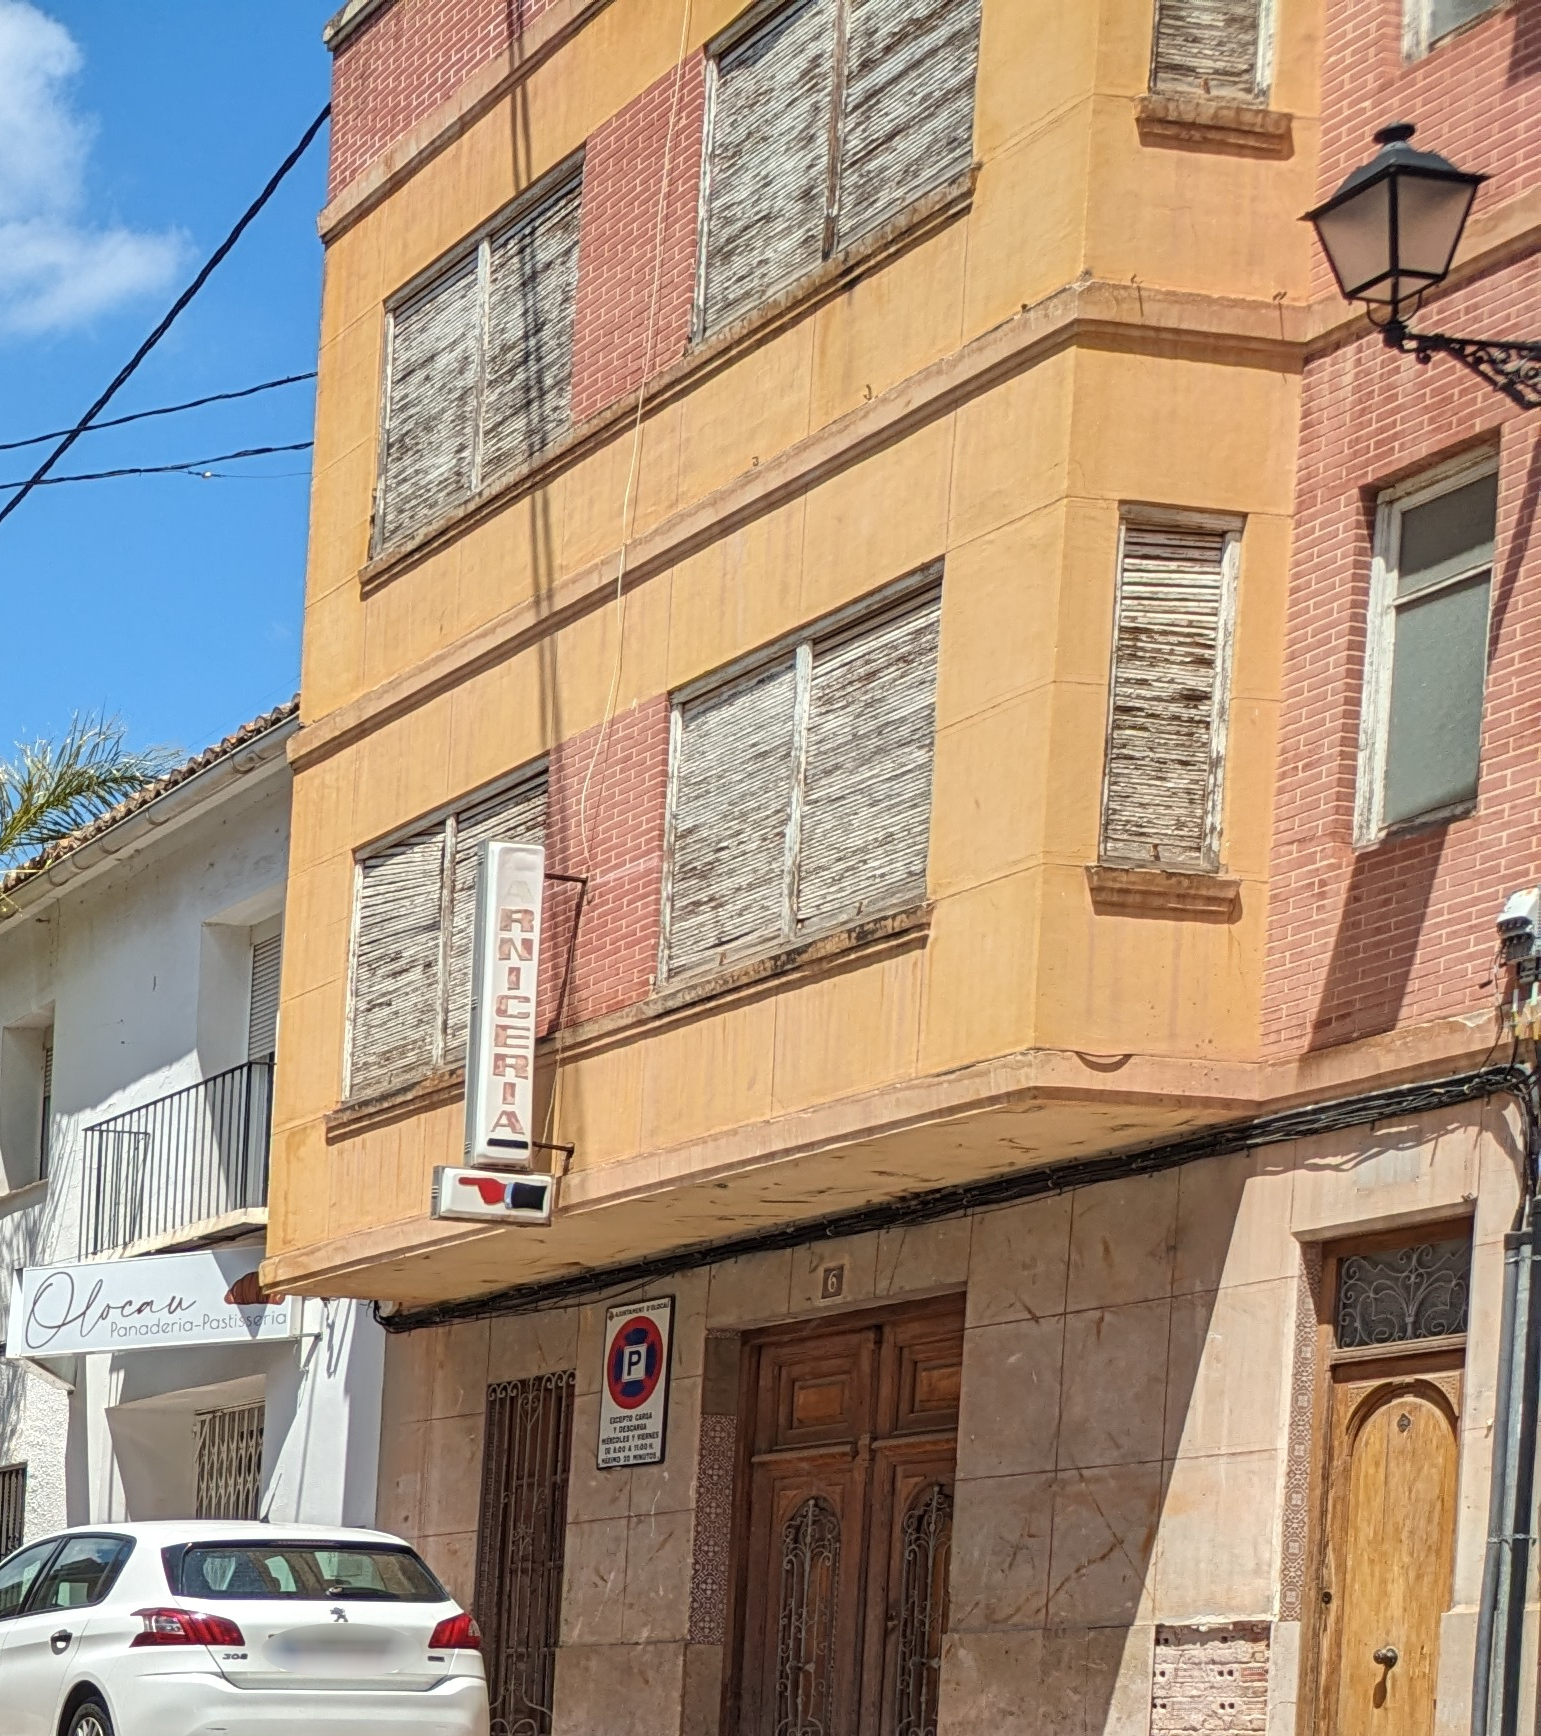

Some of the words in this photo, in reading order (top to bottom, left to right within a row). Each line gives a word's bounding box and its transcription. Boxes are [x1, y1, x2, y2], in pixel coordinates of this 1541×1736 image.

[827, 1270, 839, 1293] 6
[25, 1271, 197, 1349] Olocau
[110, 1311, 287, 1339] Panaderia-Pastisseria
[626, 1349, 642, 1376] P
[222, 1652, 249, 1660] 308
